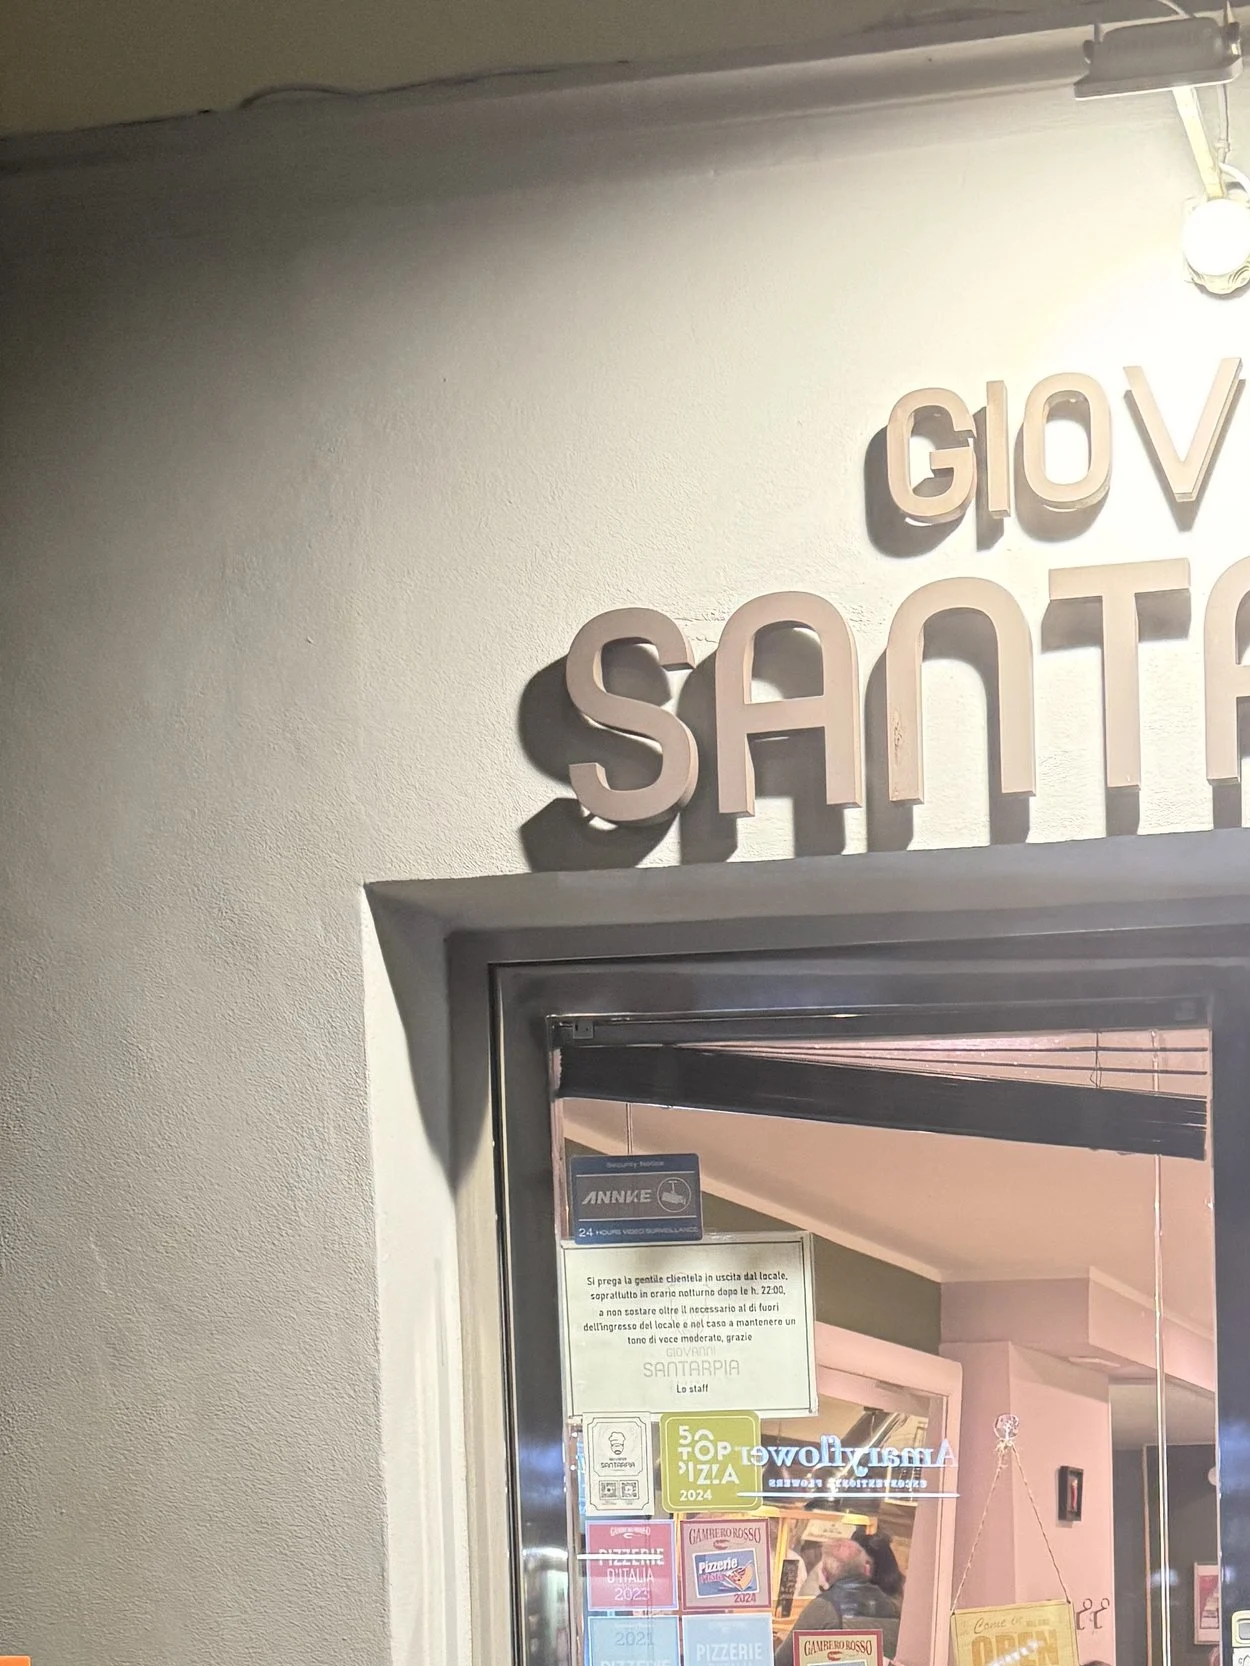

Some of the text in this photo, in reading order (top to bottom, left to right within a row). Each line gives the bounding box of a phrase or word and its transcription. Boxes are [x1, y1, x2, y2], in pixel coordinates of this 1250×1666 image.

[582, 1189, 653, 1205] ANNKE
[578, 1228, 593, 1238] 24
[586, 1276, 595, 1286] Si
[597, 1278, 622, 1288] prega
[624, 1275, 632, 1285] la
[634, 1274, 664, 1287] gentile
[666, 1273, 703, 1284] clientela
[705, 1272, 713, 1282] in
[715, 1272, 741, 1282] uscita
[743, 1271, 757, 1281] dal
[590, 1291, 638, 1302] soprattutto
[640, 1289, 648, 1299] in
[650, 1290, 676, 1299] orario
[678, 1288, 715, 1298] notturno
[717, 1287, 738, 1298] dopo
[740, 1286, 749, 1296] le
[750, 1285, 759, 1295] h.
[606, 1308, 622, 1317] non
[624, 1306, 657, 1317] sostare
[659, 1305, 679, 1315] oltre
[689, 1303, 736, 1314] necessario
[738, 1303, 747, 1313] al
[748, 1302, 757, 1312] di
[759, 1301, 779, 1312] fuori
[583, 1321, 637, 1333] dell'ingresso
[639, 1320, 653, 1330] del
[654, 1319, 681, 1330] locale
[690, 1318, 705, 1329] nel
[706, 1319, 727, 1328] caso
[736, 1317, 783, 1327] mantenere
[785, 1317, 796, 1326] un
[627, 1335, 647, 1345] tono
[648, 1334, 657, 1344] di
[659, 1335, 679, 1344] voce
[726, 1331, 753, 1344] grazie
[666, 1345, 717, 1358] GIOVANNI
[643, 1359, 740, 1378] SANTARPIA
[676, 1383, 709, 1394] Lo staff
[678, 1440, 732, 1462] TOP
[679, 1489, 713, 1502] 2024
[698, 1556, 738, 1575] Pizzerie
[696, 1642, 763, 1662] PIZZERIE
[804, 1639, 873, 1657] GAMBERO ROSSO
